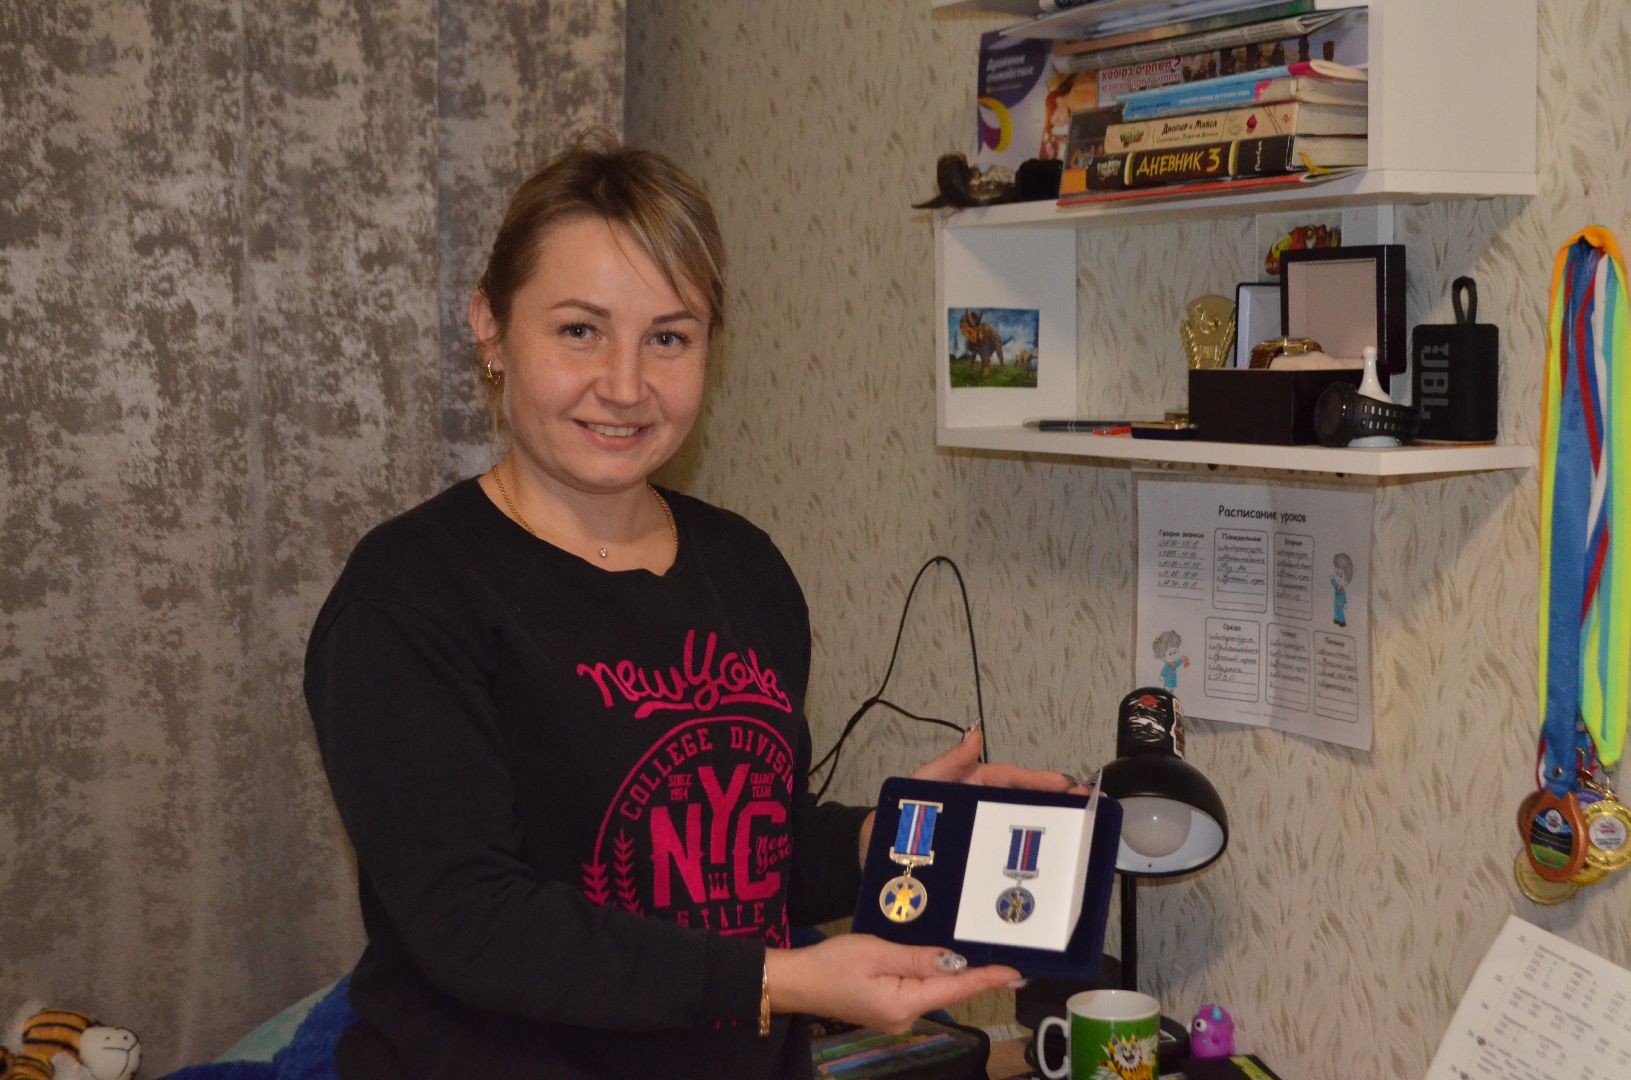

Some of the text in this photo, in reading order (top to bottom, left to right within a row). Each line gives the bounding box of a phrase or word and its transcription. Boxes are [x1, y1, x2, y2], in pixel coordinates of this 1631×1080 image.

[1136, 151, 1204, 177] ДНЕВНИК
[1206, 147, 1222, 173] 3
[1218, 504, 1307, 525] Расписание уроков
[683, 629, 790, 712] Yok
[619, 727, 713, 821] COLLEGE
